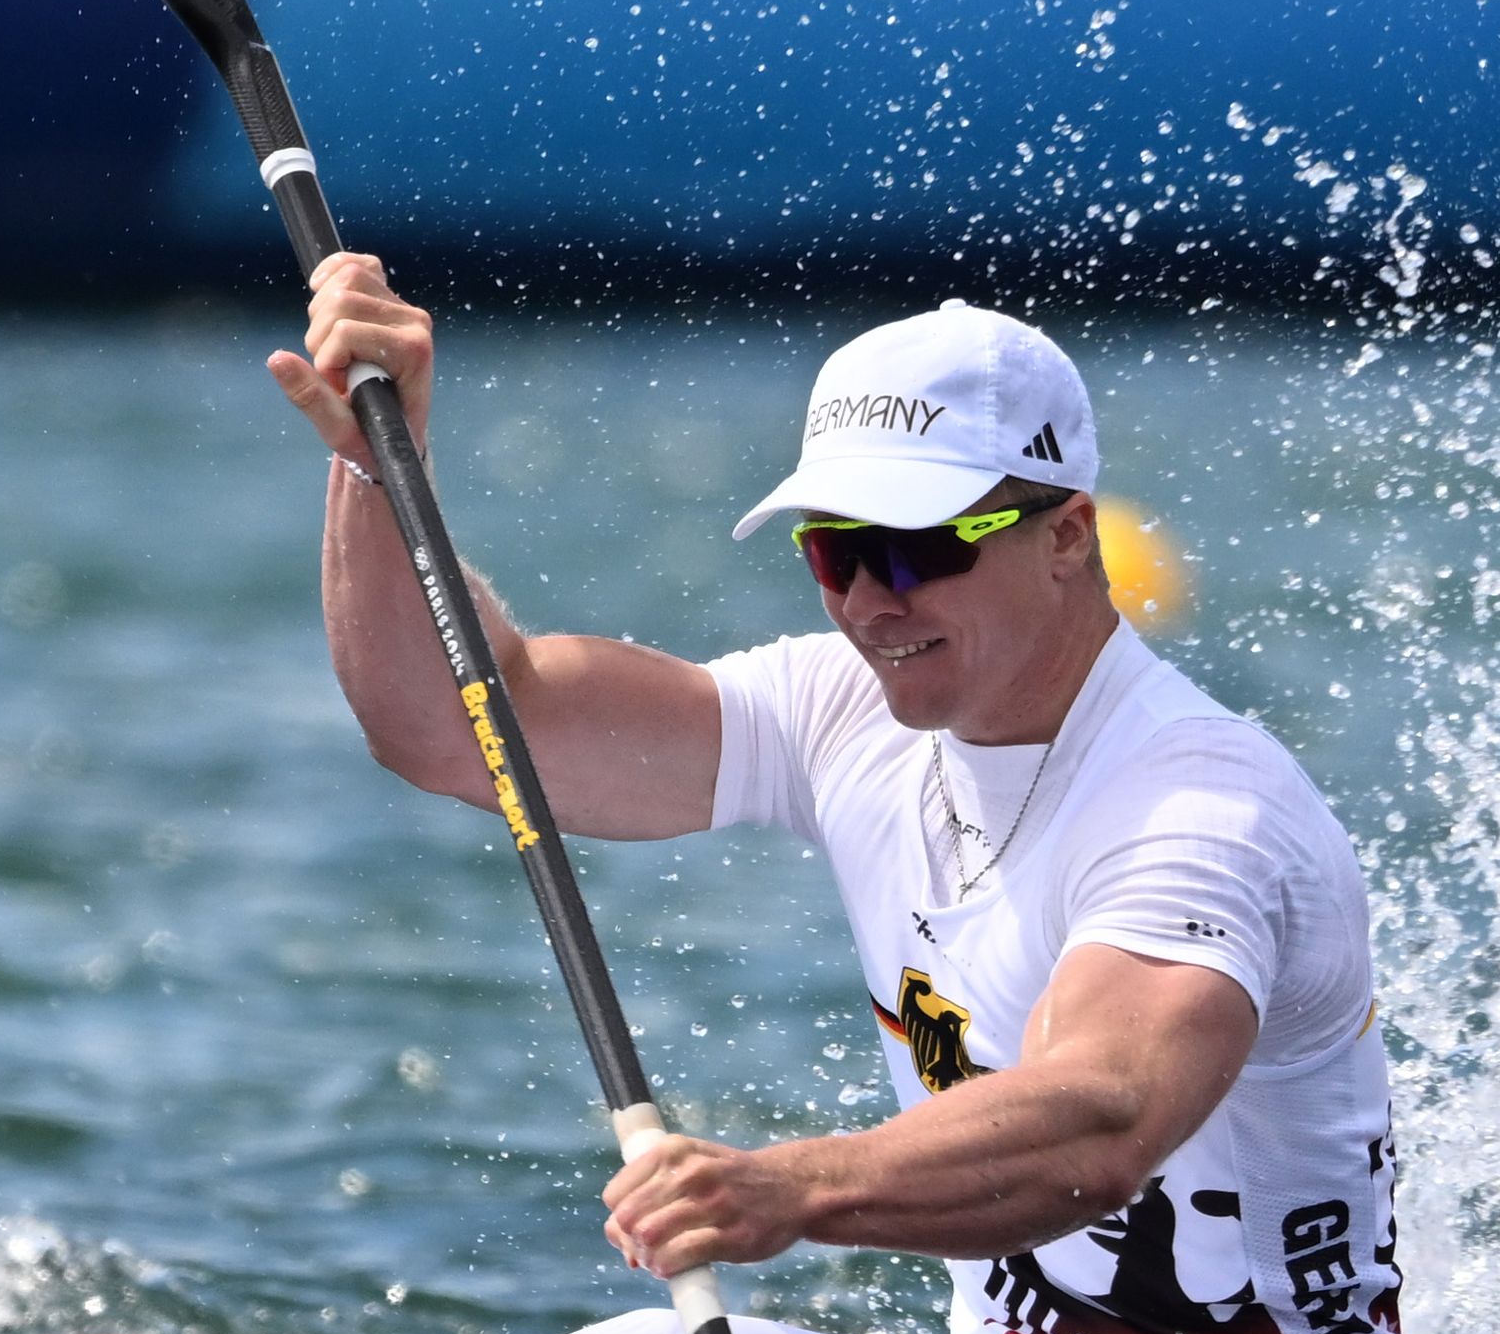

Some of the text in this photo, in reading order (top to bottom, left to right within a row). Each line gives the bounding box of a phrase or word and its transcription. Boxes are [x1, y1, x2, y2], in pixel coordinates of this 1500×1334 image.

[804, 394, 947, 444] GERMANY
[422, 574, 467, 677] PARIS 2024
